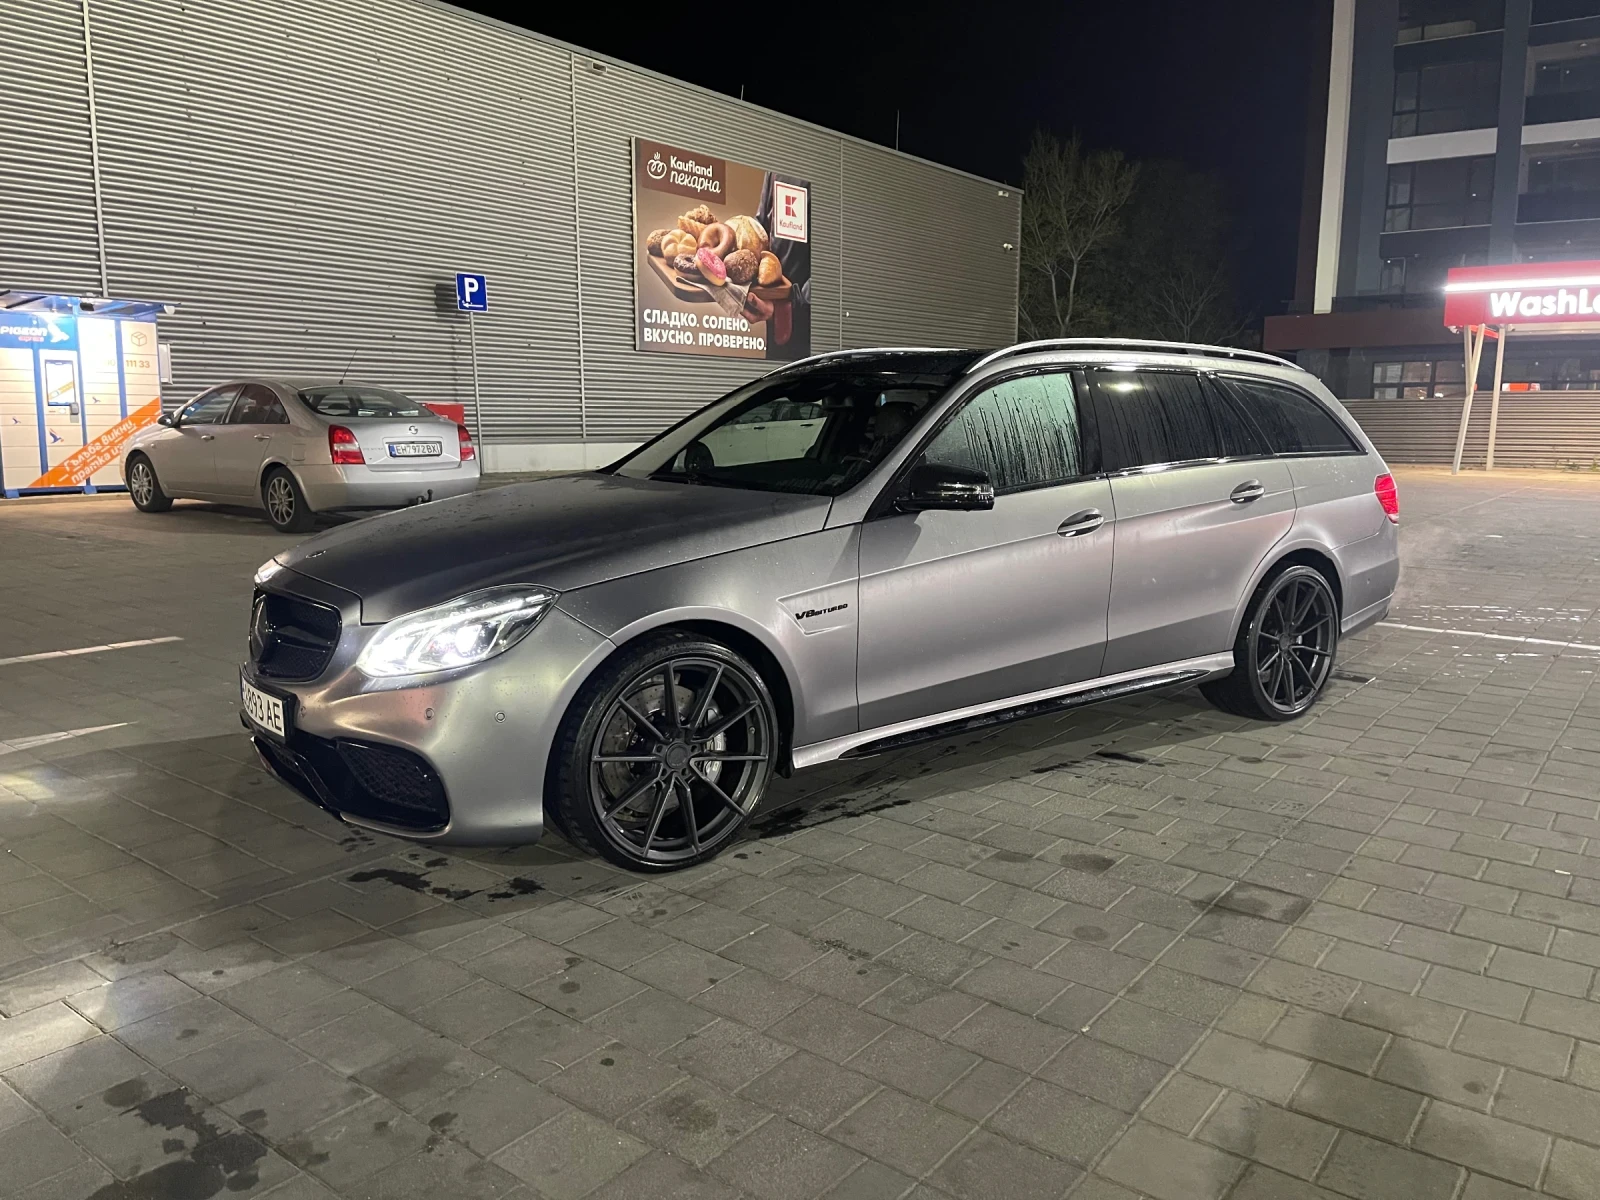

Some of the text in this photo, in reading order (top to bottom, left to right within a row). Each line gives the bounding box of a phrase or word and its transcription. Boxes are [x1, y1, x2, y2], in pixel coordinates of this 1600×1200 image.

[670, 155, 713, 178] Kaufland
[779, 219, 803, 231] Kaufland
[464, 277, 479, 303] P
[643, 308, 751, 332] СЛАДКО. СОЛЕНО.
[643, 327, 767, 351] ВКУСНО. ПРОВЕРЕНО.
[138, 360, 151, 369] 33
